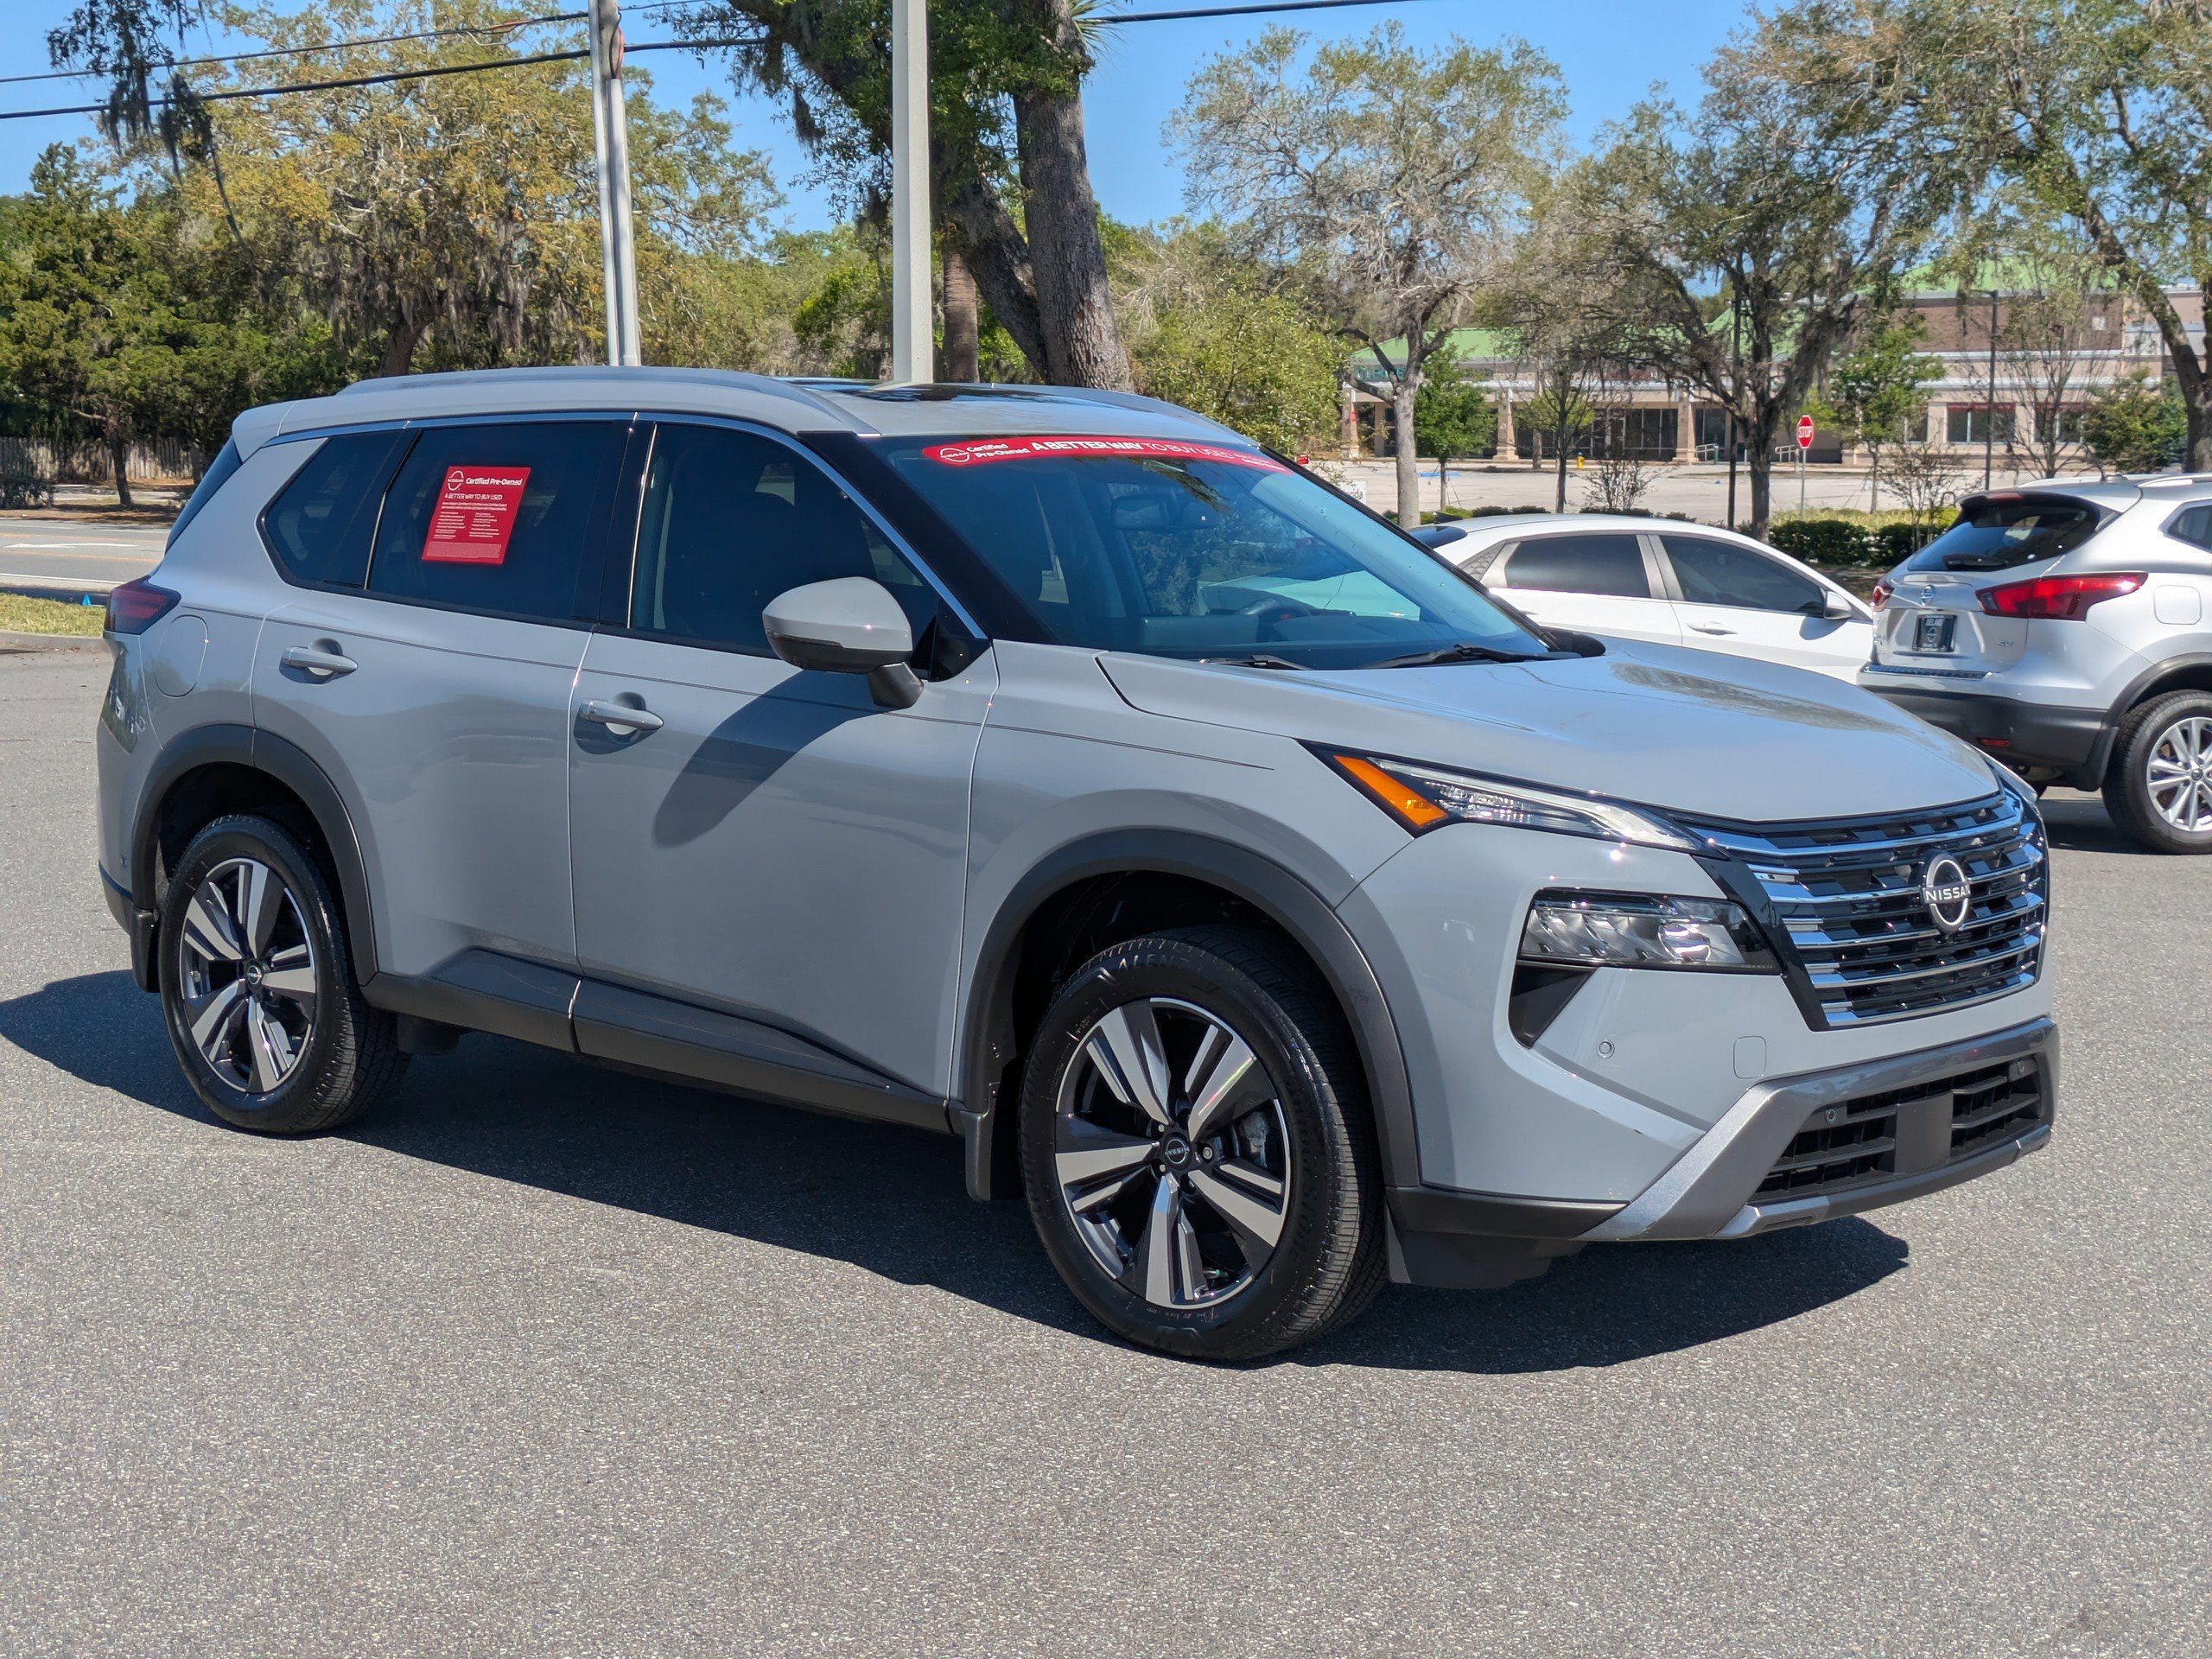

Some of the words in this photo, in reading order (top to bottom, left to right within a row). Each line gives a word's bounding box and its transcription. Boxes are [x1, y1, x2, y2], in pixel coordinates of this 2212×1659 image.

[1798, 425, 1813, 438] STOP
[966, 443, 1009, 452] Certified
[974, 448, 1031, 458] Pre-Owned
[1031, 442, 1049, 451] A
[1043, 441, 1112, 450] BETTER
[1107, 442, 1143, 450] WAY
[1141, 442, 1167, 452] TO
[1165, 444, 1198, 454] BUY
[1193, 448, 1235, 460] USED
[465, 477, 490, 486] Certified
[1925, 884, 1971, 901] NISSAN
